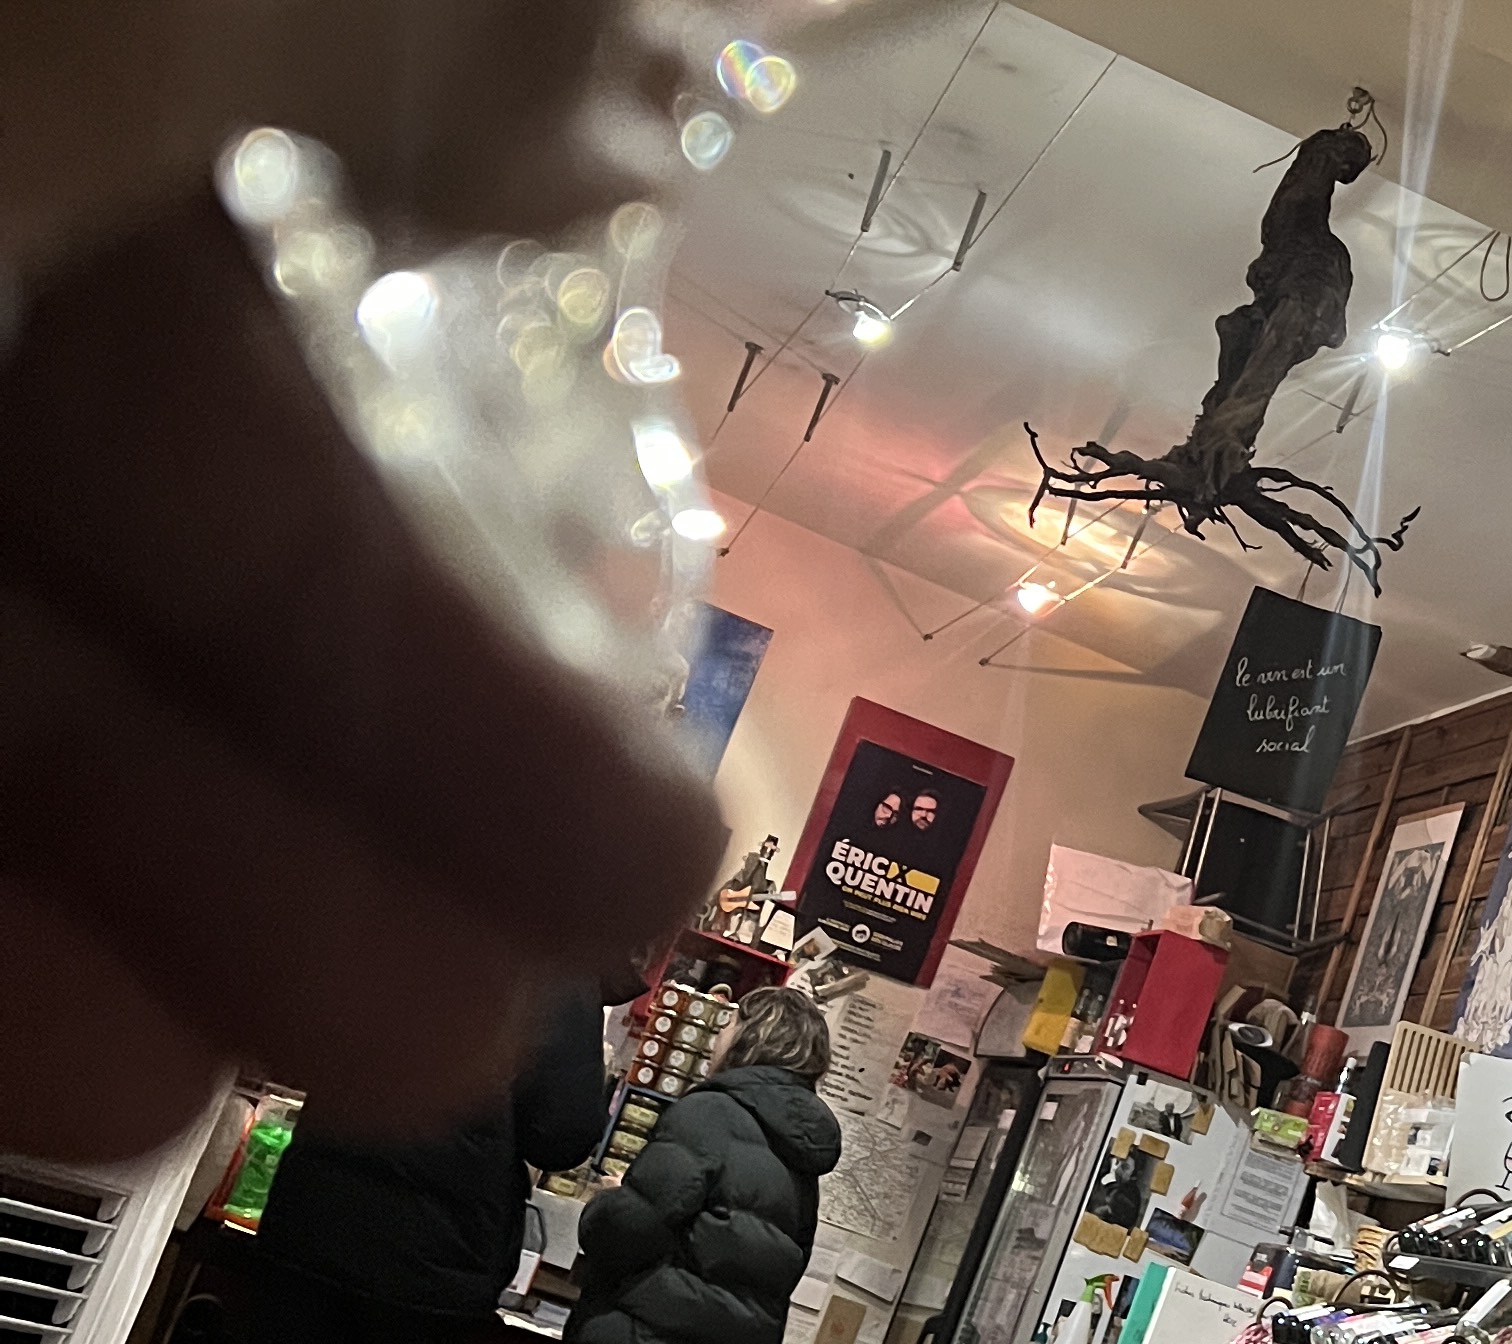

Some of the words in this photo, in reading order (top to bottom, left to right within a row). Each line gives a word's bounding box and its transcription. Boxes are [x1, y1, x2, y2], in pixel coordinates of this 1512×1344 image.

[1257, 668, 1290, 685] vin
[1292, 658, 1313, 680] est
[1317, 661, 1347, 677] un
[1246, 693, 1331, 732] lubrifiant
[1255, 724, 1317, 754] social
[831, 838, 890, 877] ÉRIC
[825, 861, 935, 914] QUENTIN
